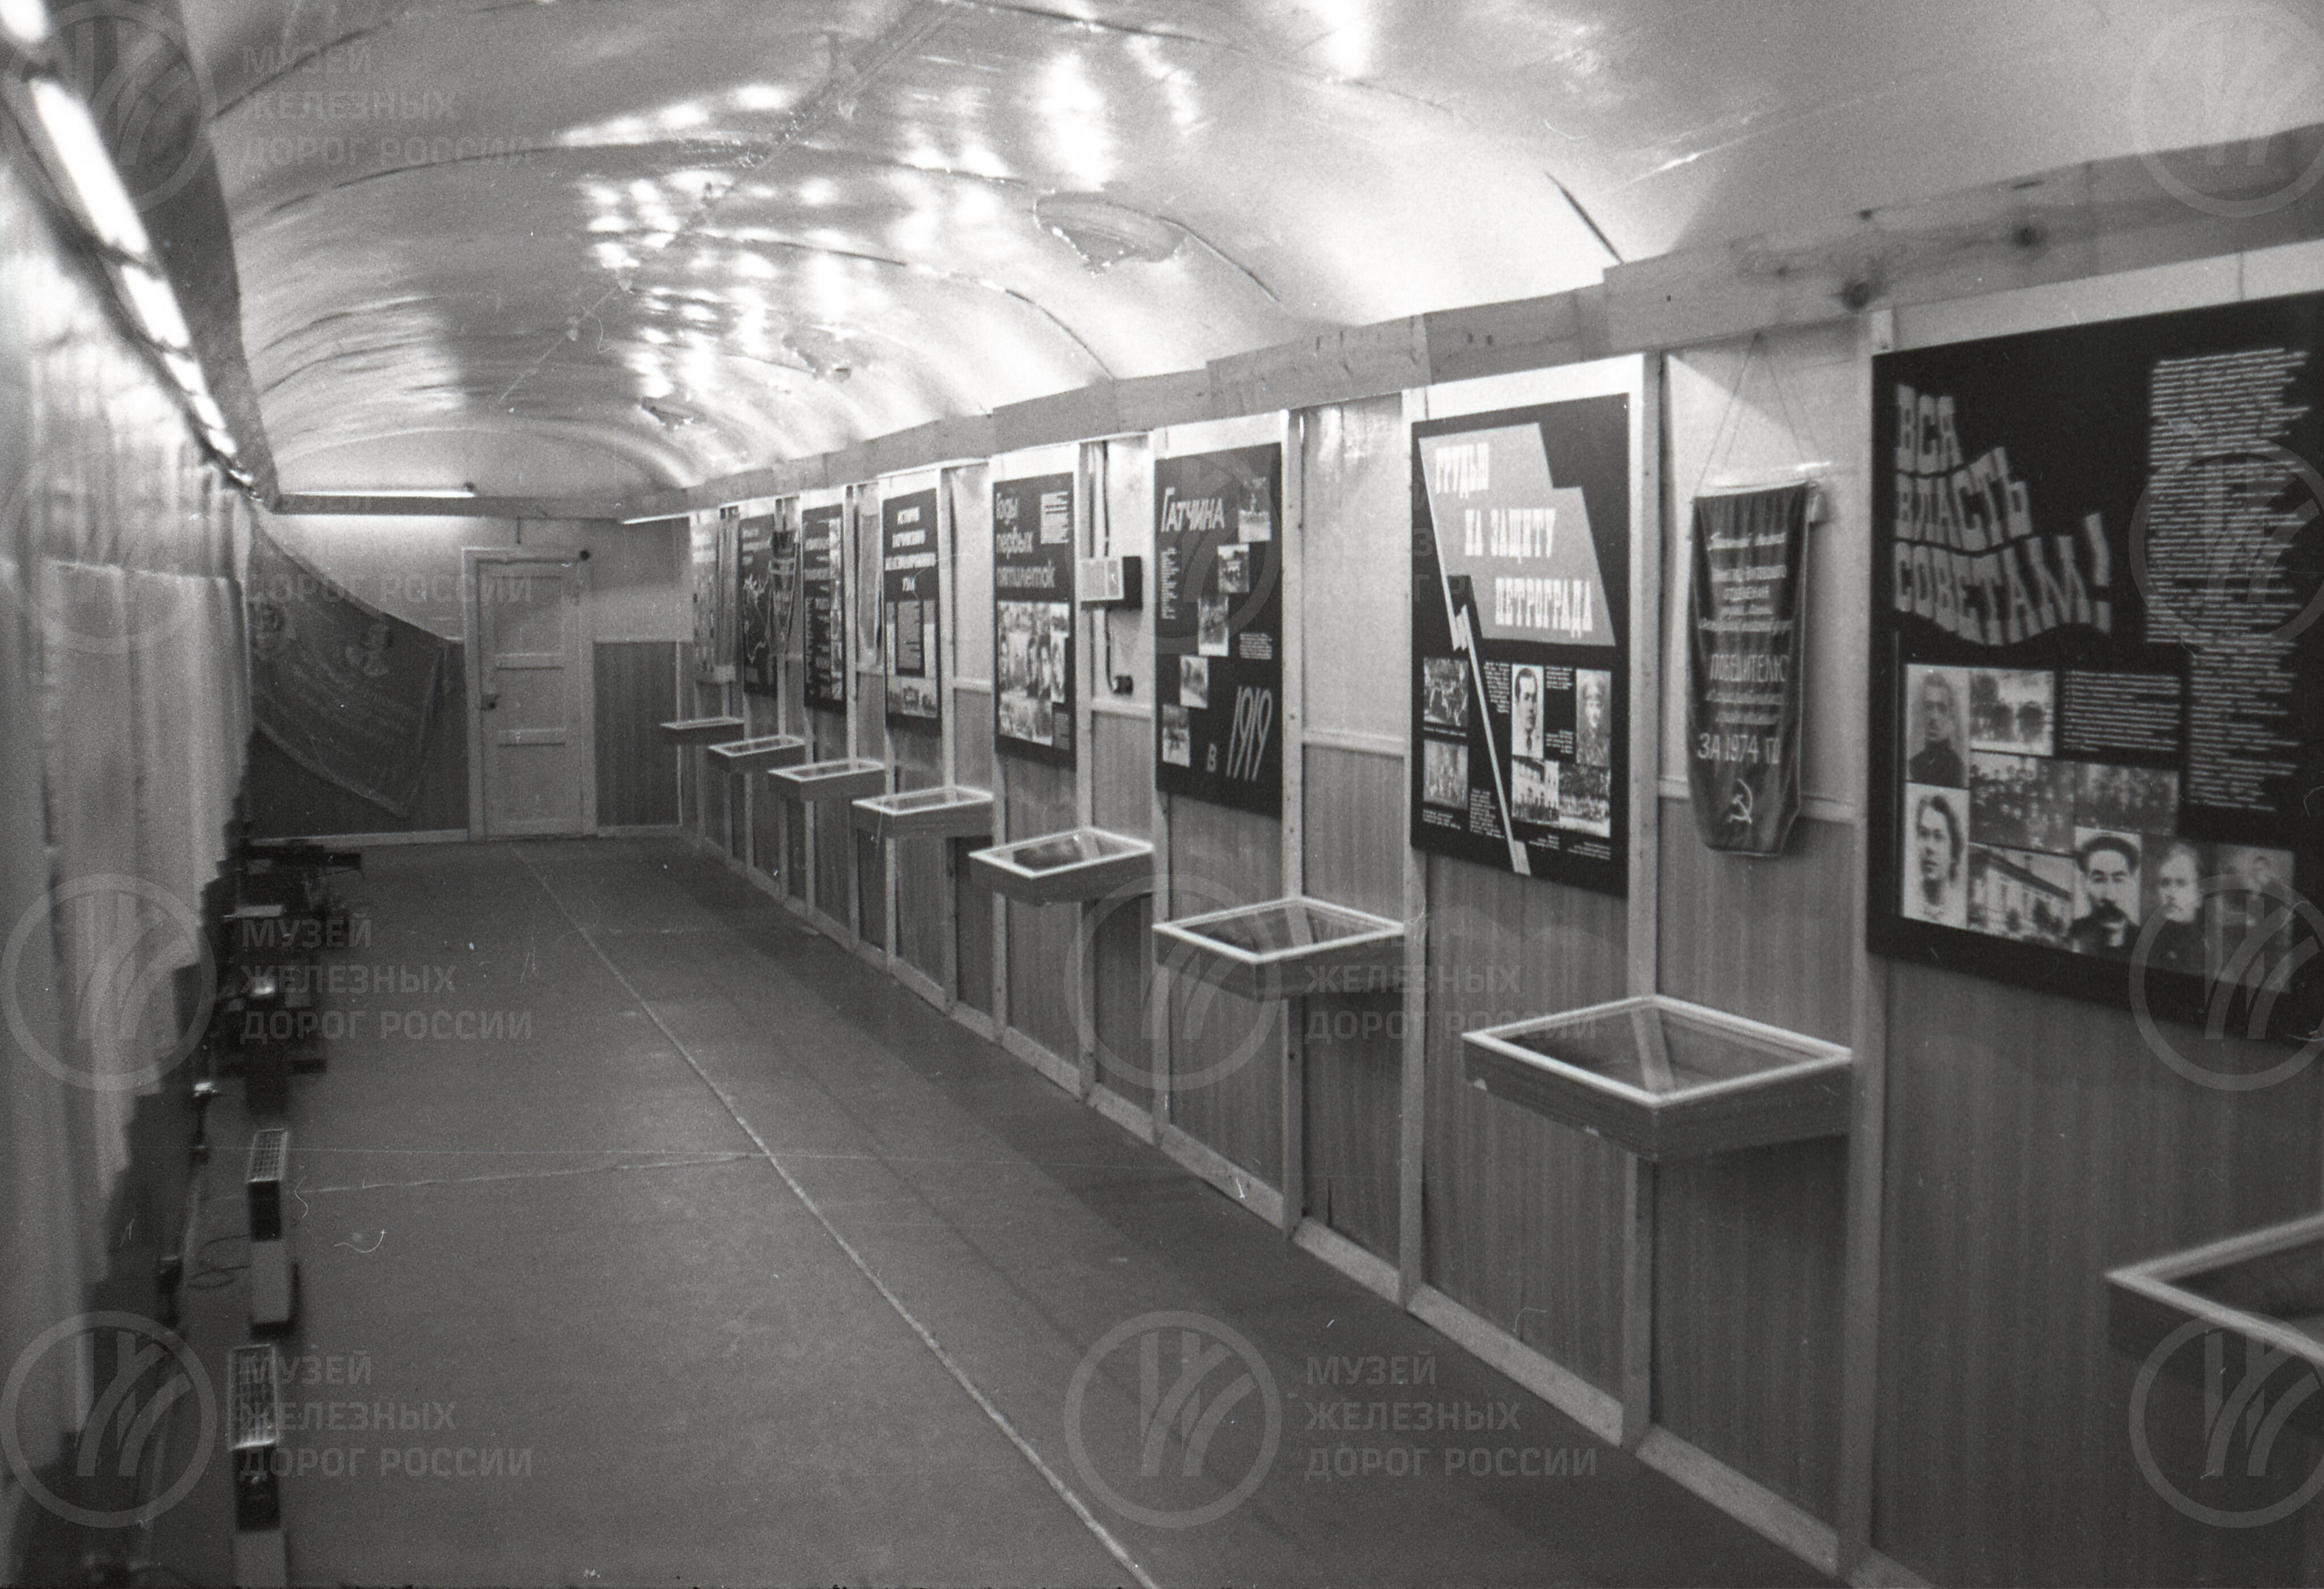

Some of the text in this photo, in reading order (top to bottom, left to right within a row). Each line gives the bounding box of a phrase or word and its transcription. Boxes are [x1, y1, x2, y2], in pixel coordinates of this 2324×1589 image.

[1896, 383, 1964, 474] ВСЯ
[1465, 508, 1483, 557] НА
[1491, 508, 1556, 565] ЗАЩИТУ
[1895, 446, 2034, 554] ВЛАСТЬ
[1495, 577, 1593, 638] ПЕТРОГРАДА
[1894, 512, 2112, 646] СОВЕТАМ!
[1227, 686, 1273, 781] 1919
[1698, 732, 1720, 761] ЗА
[1725, 733, 1759, 764] 1974
